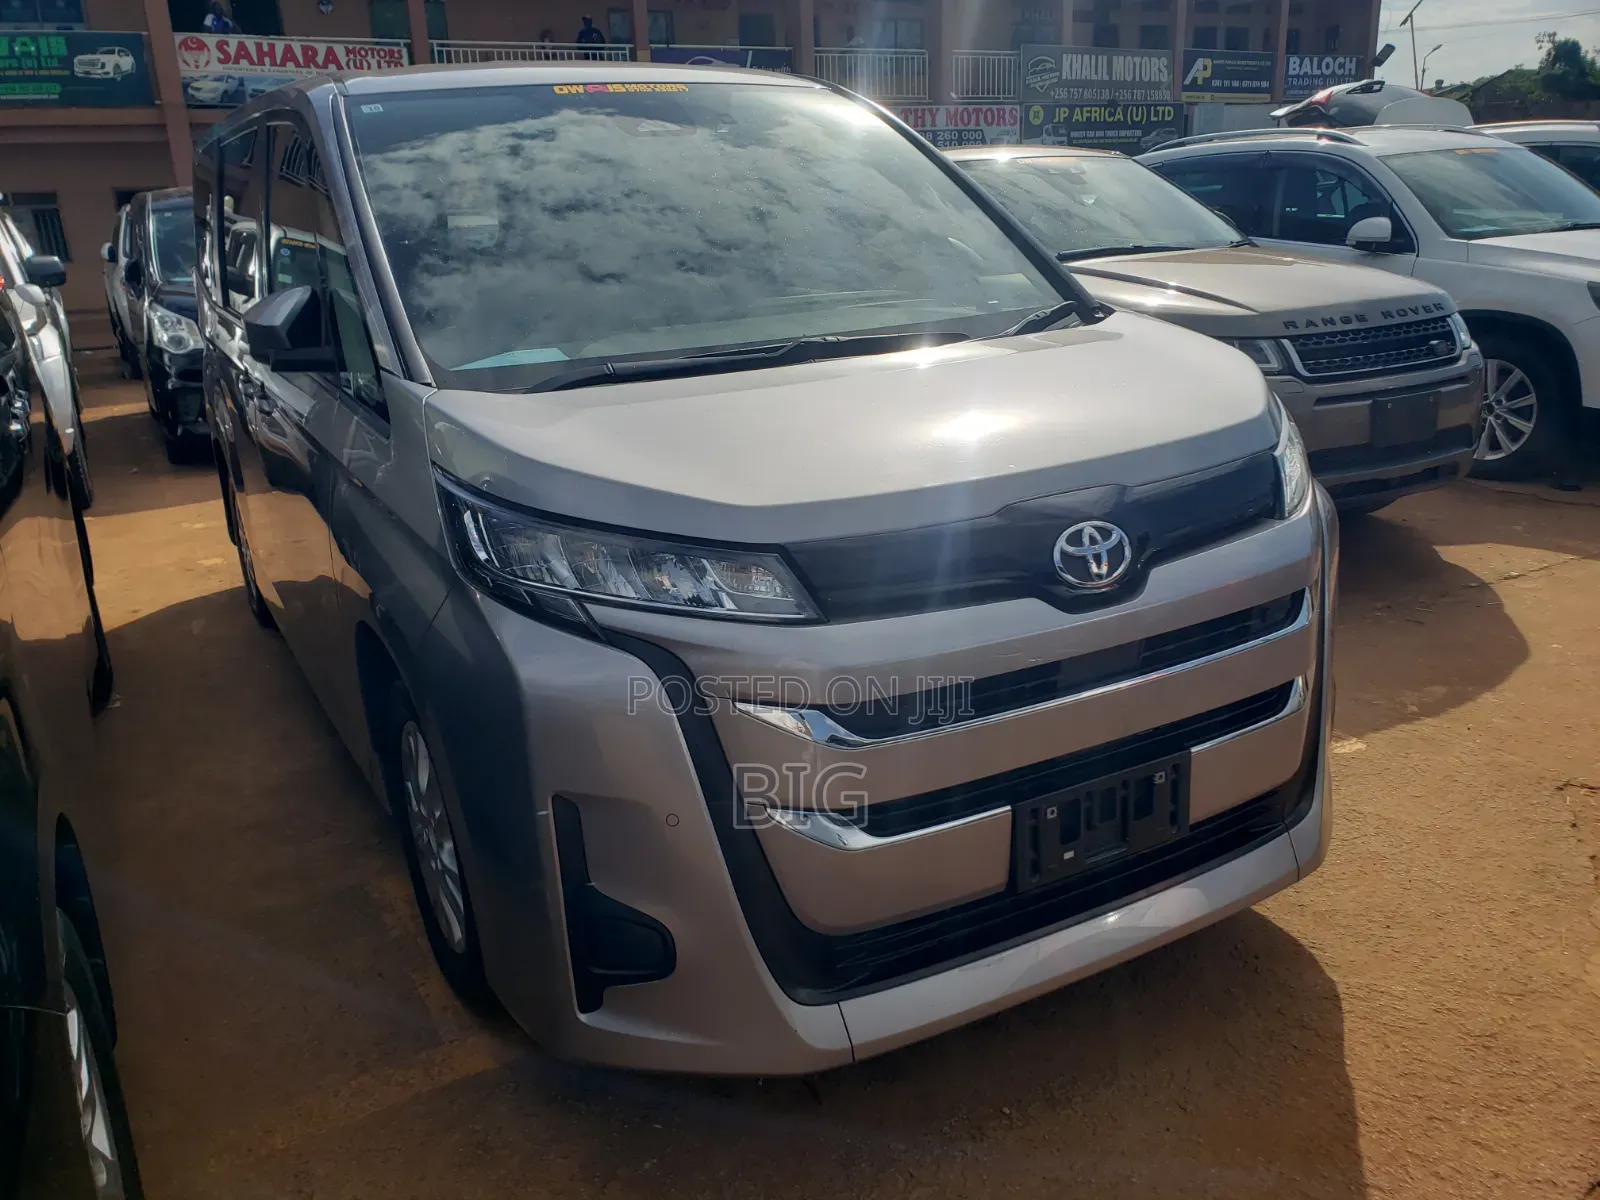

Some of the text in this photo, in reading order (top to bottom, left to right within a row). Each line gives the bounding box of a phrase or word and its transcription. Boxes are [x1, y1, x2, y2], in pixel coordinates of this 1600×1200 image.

[215, 39, 344, 70] SAHARA
[344, 45, 404, 60] MOTORS
[1062, 53, 1110, 81] KHALIL
[1112, 55, 1168, 82] MOTORS
[1288, 56, 1357, 76] BALOCH
[1287, 77, 1324, 87] TRADING
[1050, 87, 1068, 99] +256
[1069, 87, 1083, 99] 757
[1115, 88, 1132, 100] +256
[944, 106, 1018, 128] MOTORS
[1053, 106, 1174, 125] JP AFRICA (U) LTD
[936, 131, 959, 141] 260
[961, 131, 983, 140] 000
[1282, 301, 1446, 331] RANGE ROVER
